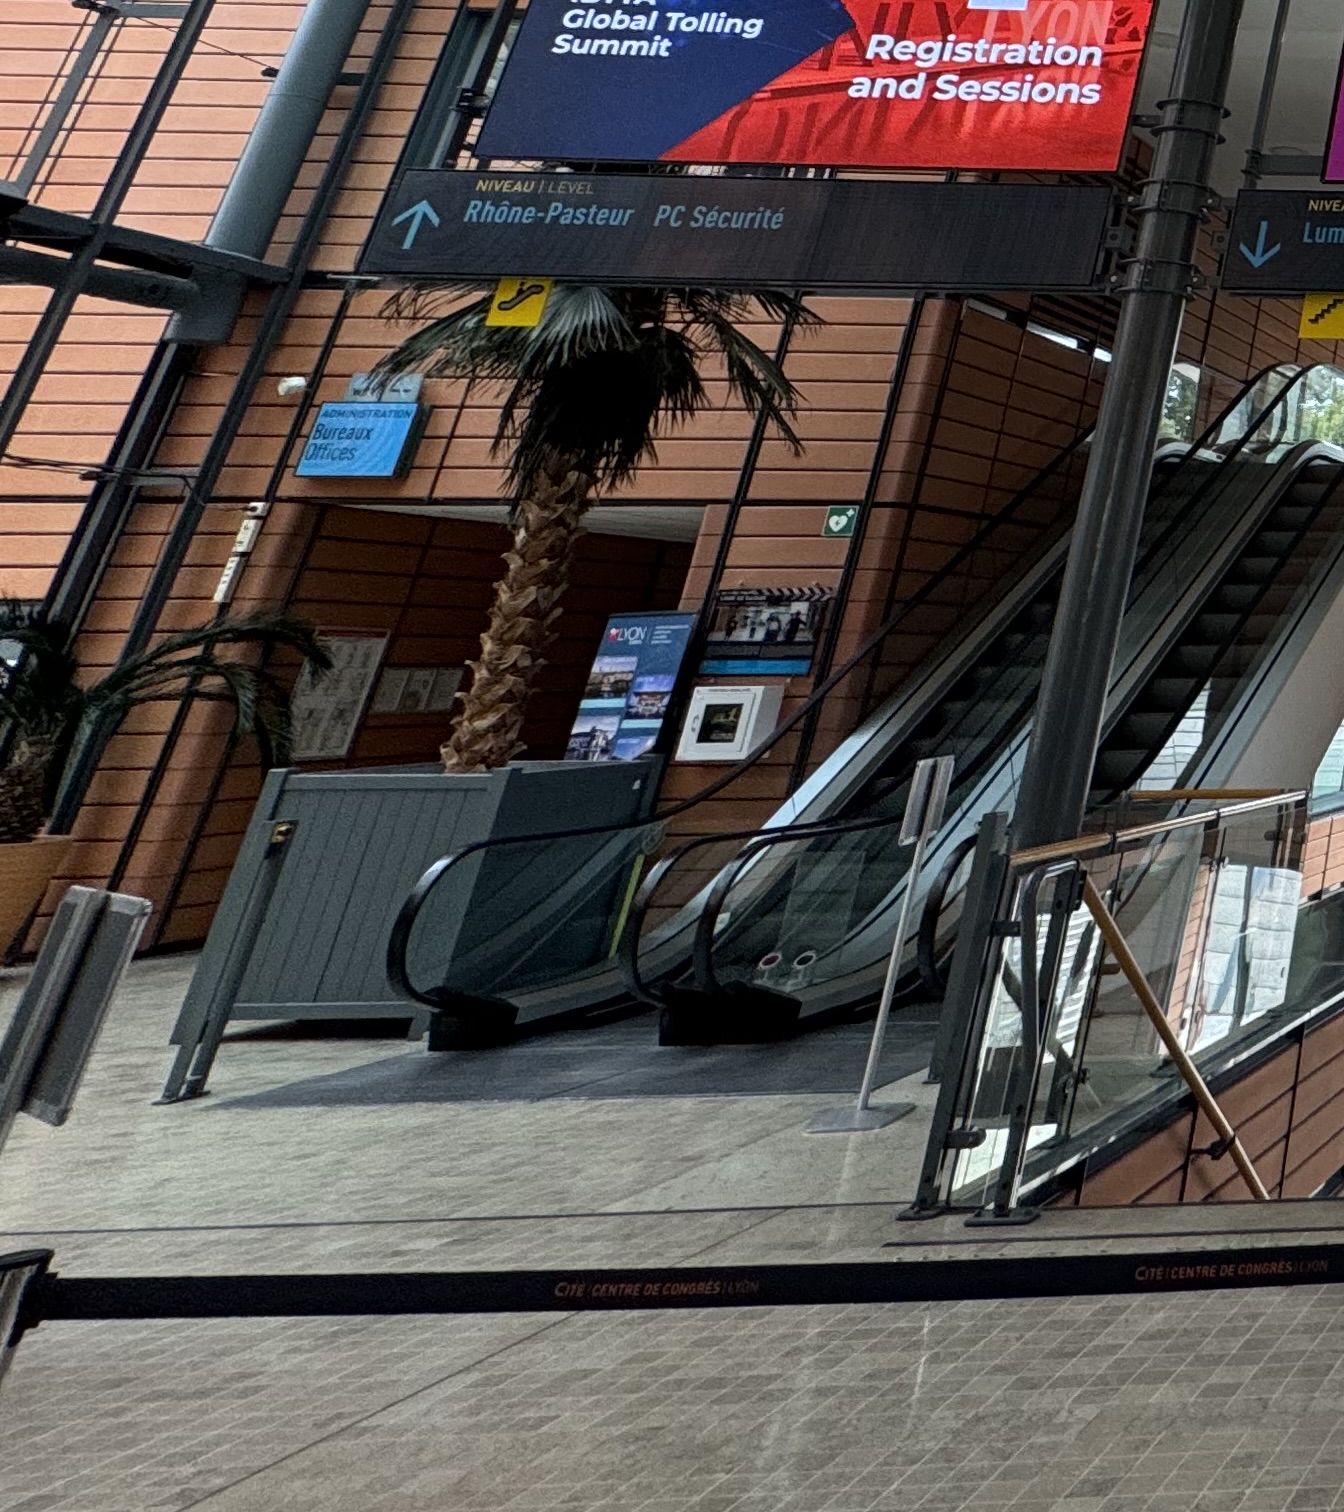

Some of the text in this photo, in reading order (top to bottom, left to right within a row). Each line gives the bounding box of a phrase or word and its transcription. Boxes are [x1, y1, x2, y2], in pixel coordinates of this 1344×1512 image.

[562, 8, 764, 39] Global Tolling
[551, 33, 673, 57] Summit
[864, 34, 1103, 68] Registration
[848, 71, 1102, 105] and Sessions
[475, 178, 594, 195] NIVEAU LEVEL
[464, 198, 785, 231] Rhône-Pasteur PC Sécurité
[320, 408, 412, 419] ADMINISTRATION
[311, 423, 374, 441] Bureaux
[304, 442, 358, 462] Offices
[1170, 1264, 1217, 1280] CENTRE
[1219, 1264, 1235, 1277] DE
[590, 1282, 642, 1298] CENTRE
[643, 1283, 660, 1297] DE
